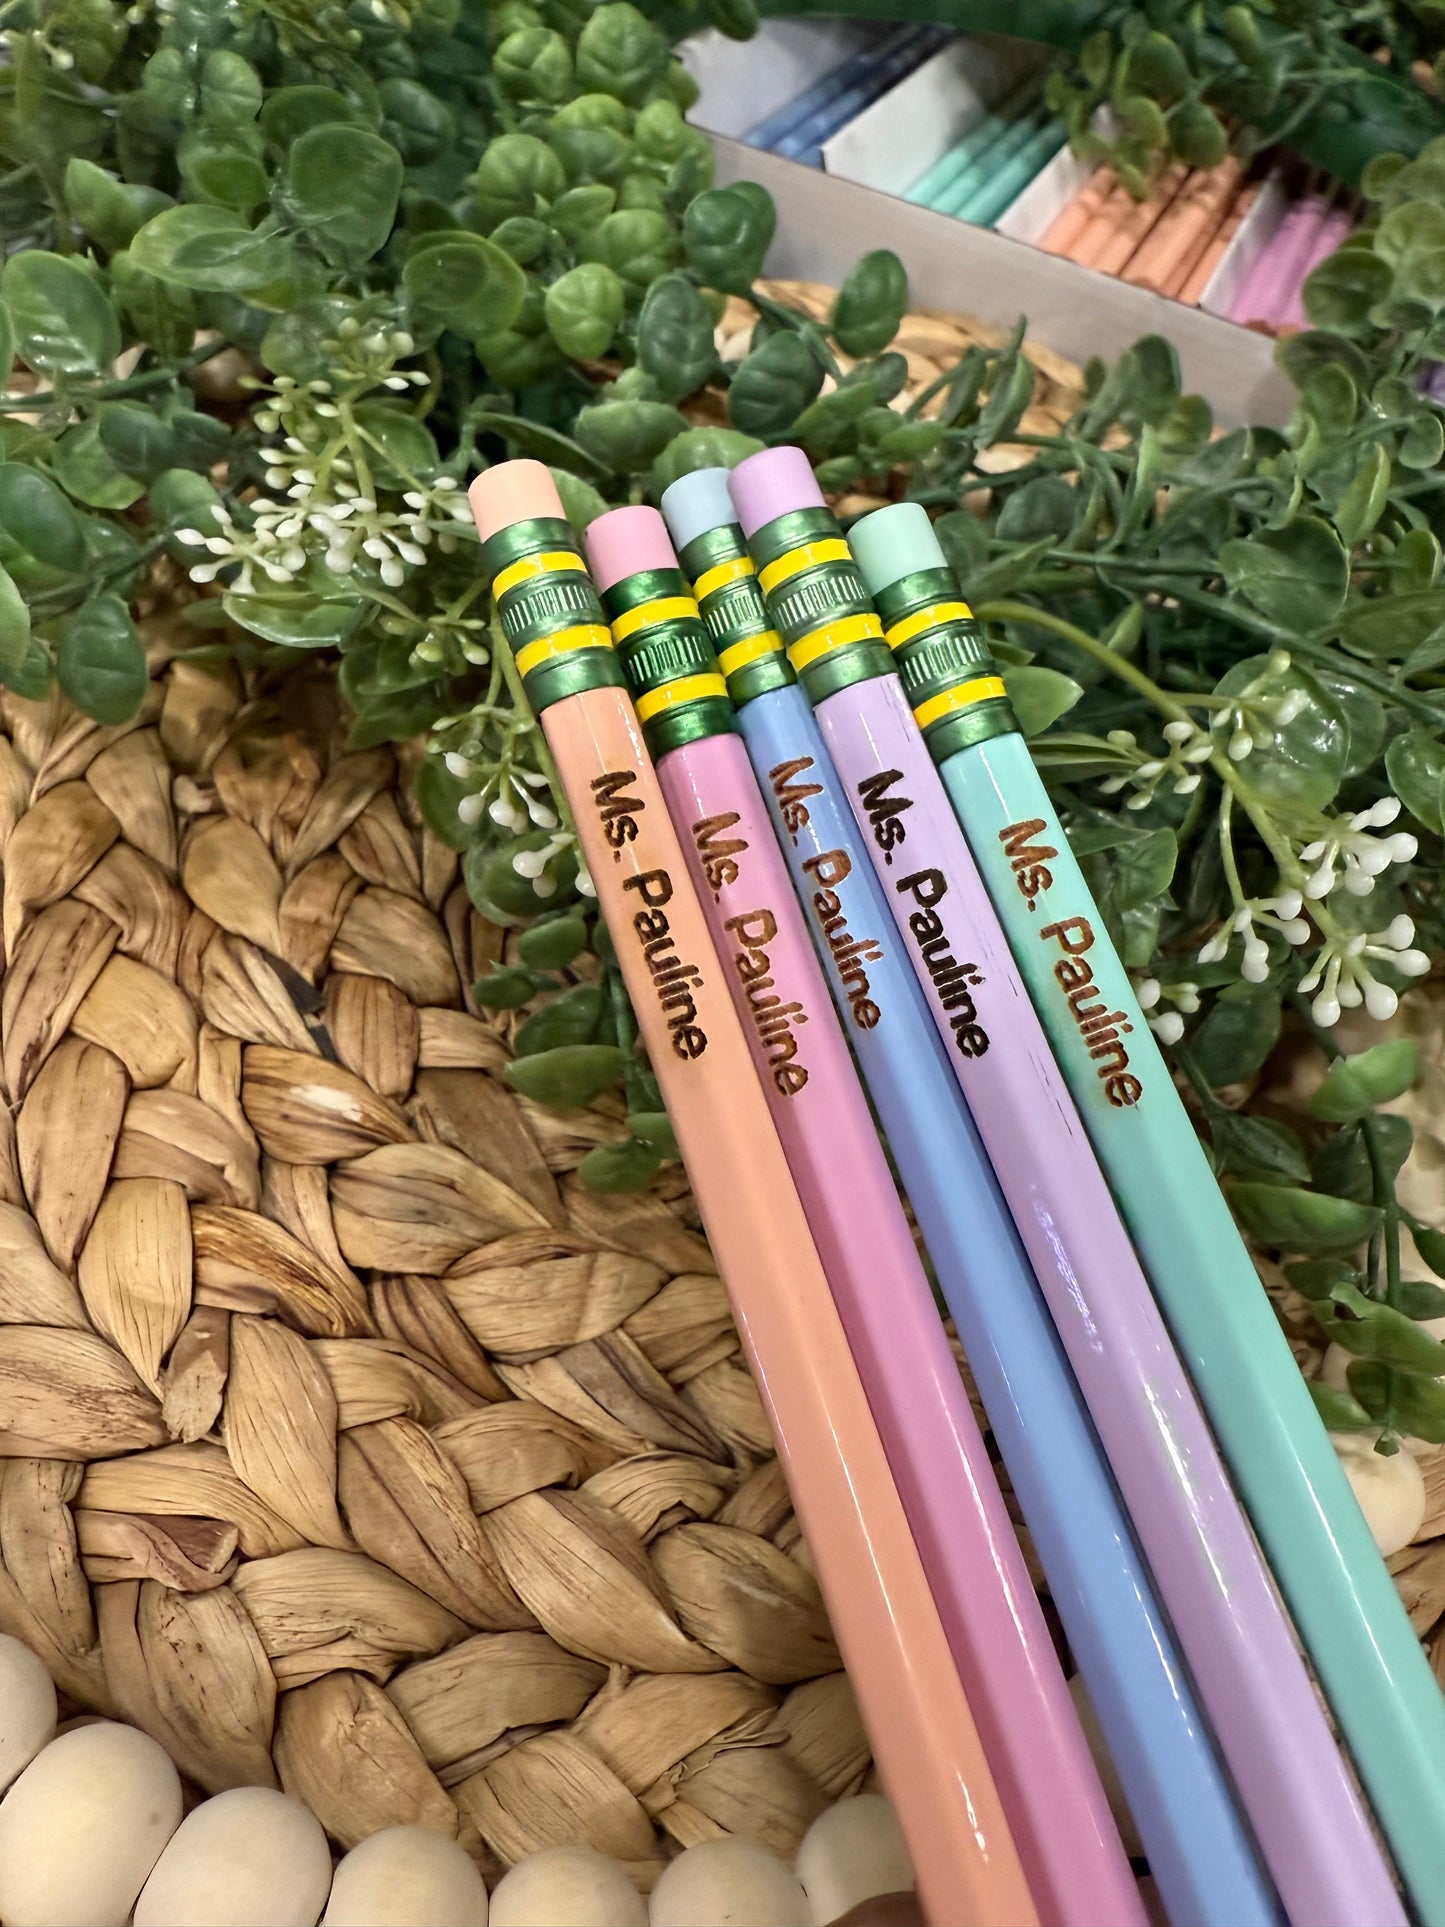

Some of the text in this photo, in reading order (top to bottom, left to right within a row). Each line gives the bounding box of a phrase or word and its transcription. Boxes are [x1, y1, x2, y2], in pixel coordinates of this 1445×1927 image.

[590, 769, 708, 1061] Ms. Pauline
[692, 811, 809, 1096] Ms. Pauline
[768, 756, 884, 1031] Ms. Pauline
[857, 769, 990, 1060] Ms. Pauline
[998, 818, 1143, 1107] Ms. Pauline
